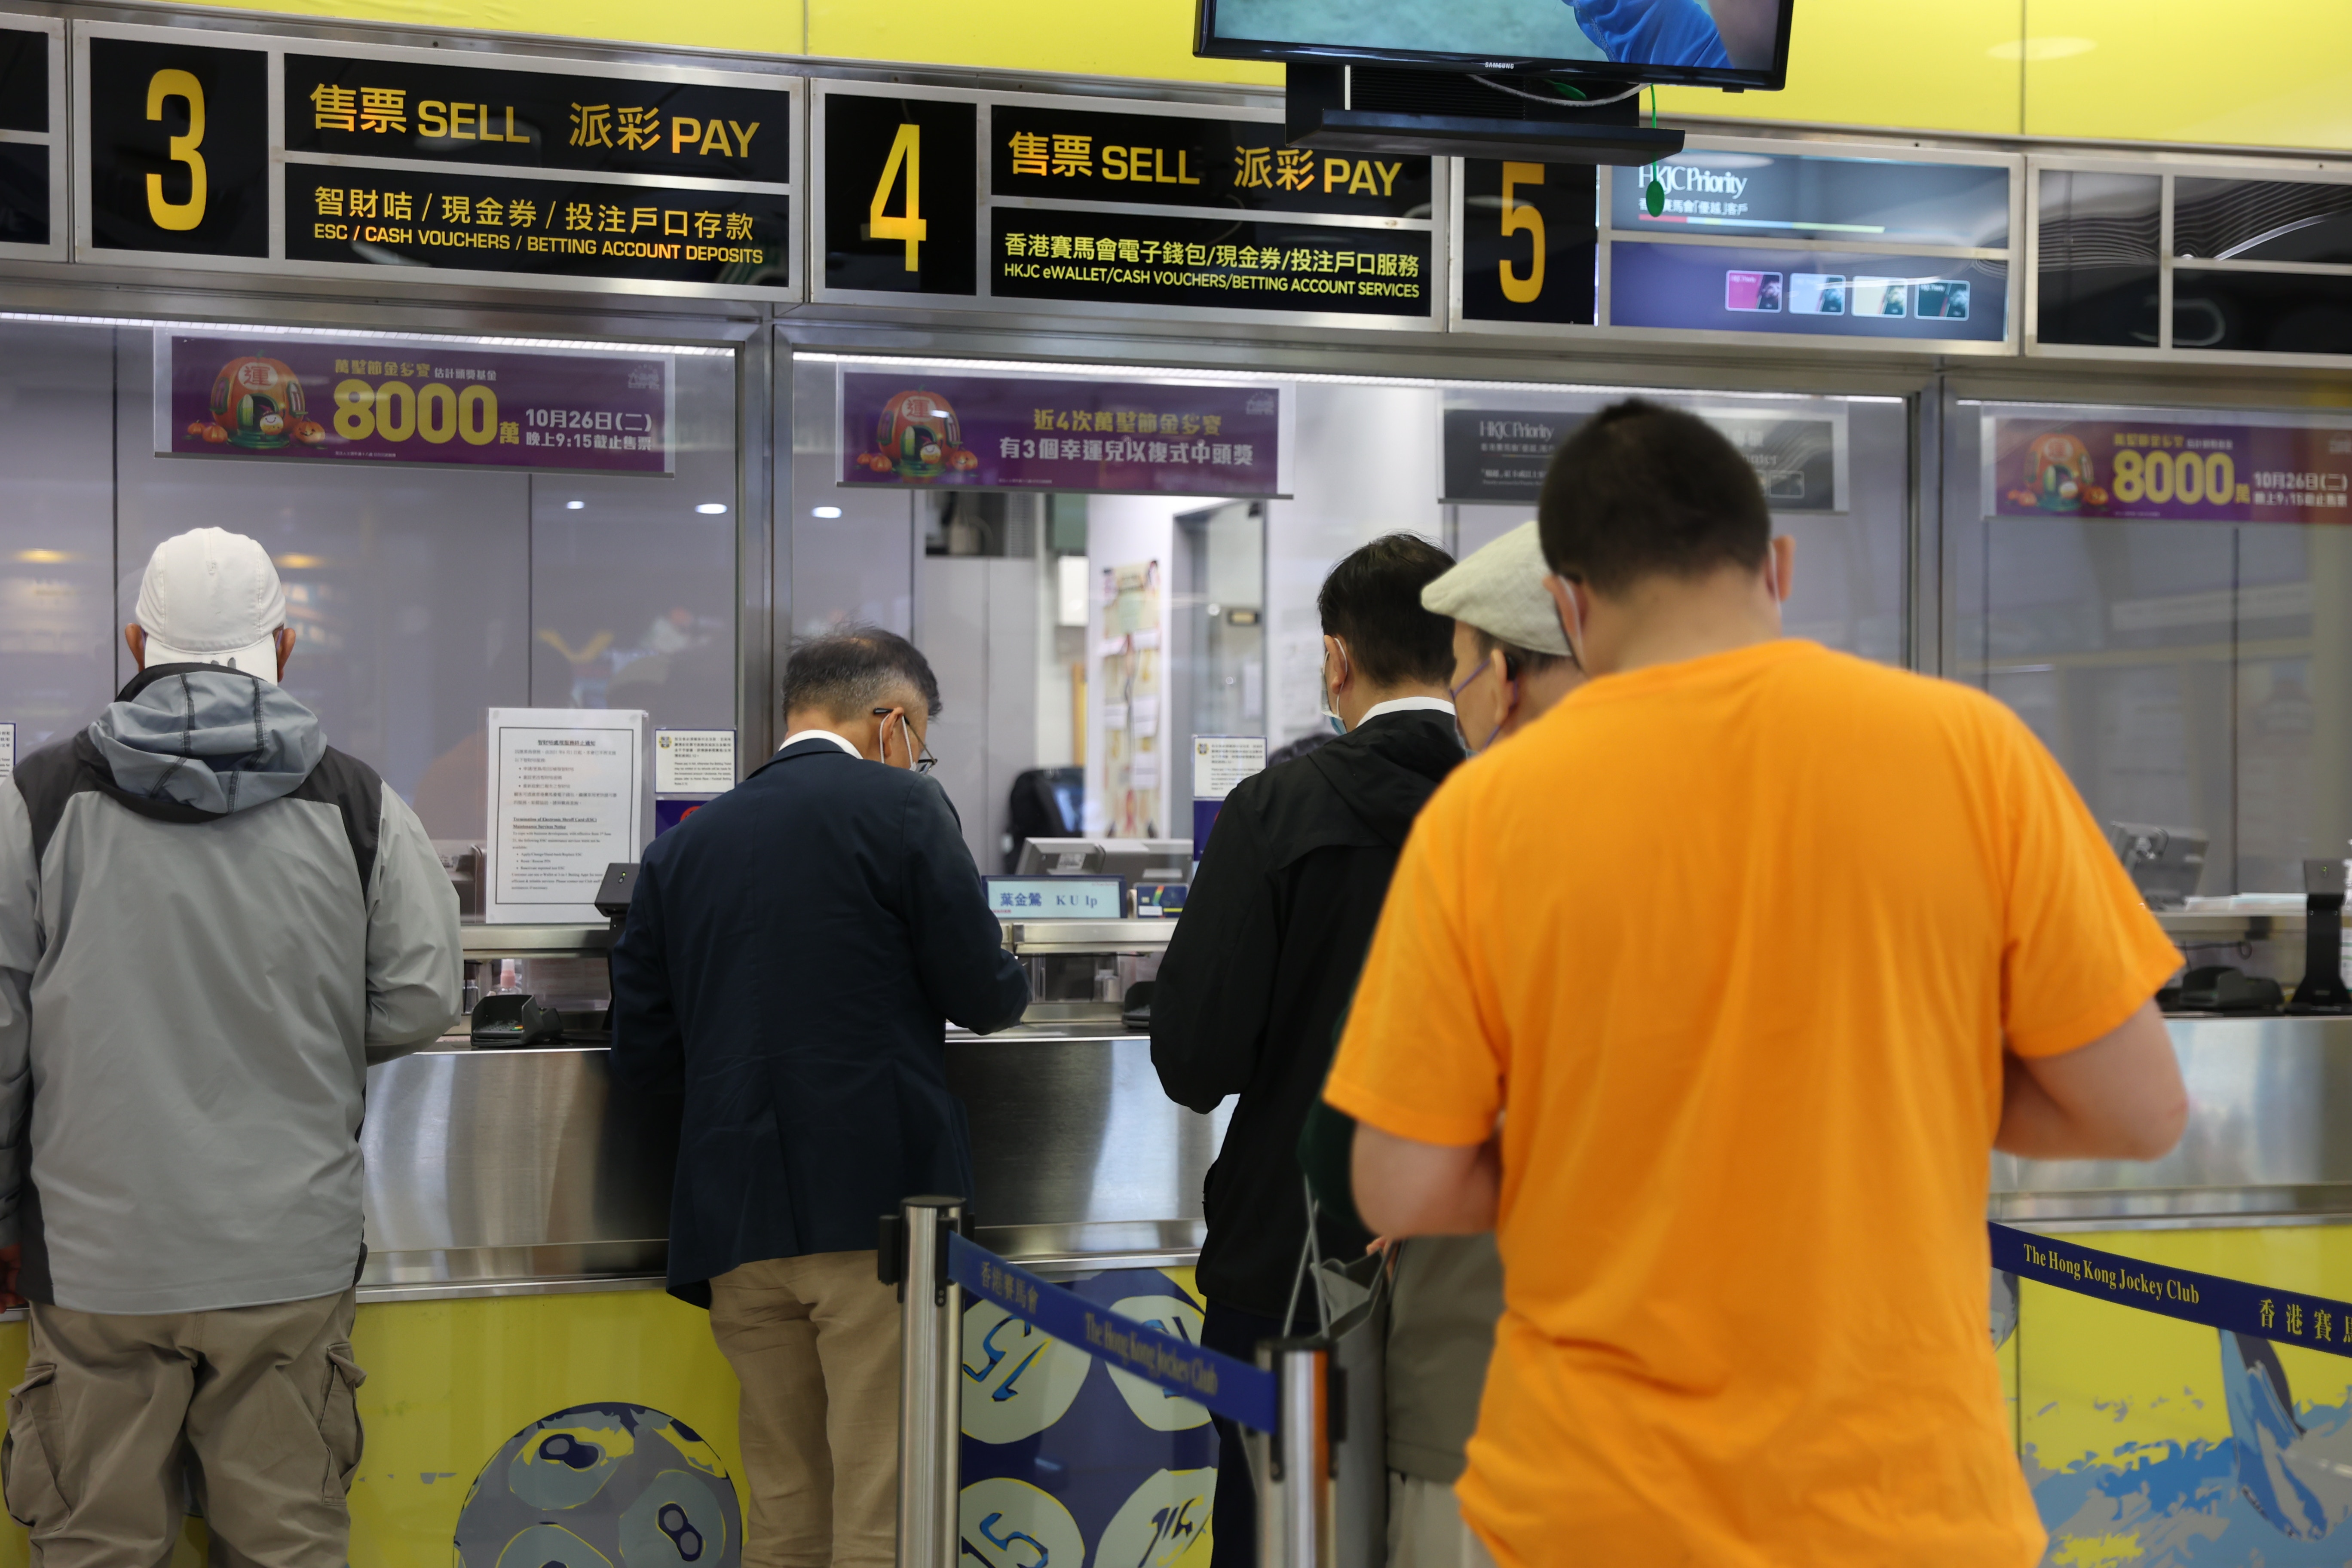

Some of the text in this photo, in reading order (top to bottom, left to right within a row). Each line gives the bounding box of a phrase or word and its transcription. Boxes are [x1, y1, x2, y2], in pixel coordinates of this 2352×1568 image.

[310, 83, 760, 157] 售票 SELL 派彩 PAY
[147, 70, 207, 231] 3
[1008, 131, 1402, 196] 售票 SELL 派彩 PAY
[315, 186, 413, 221] 智財咭
[442, 195, 536, 228] 現金券
[870, 123, 927, 272] 4
[1638, 165, 1748, 199] HKJC Priority
[315, 224, 348, 240] ESC
[365, 227, 412, 244] CASH
[418, 230, 510, 249] VOUCHERS
[527, 236, 597, 254] BETTING
[602, 241, 681, 259] ACCOUNT
[686, 245, 763, 263] DEPOSITS
[1500, 162, 1545, 303] 5
[1004, 263, 1040, 278] HKJC
[1290, 278, 1356, 295] ACCOUNT
[1358, 283, 1420, 298] SERVICES
[242, 365, 271, 388] 運
[981, 1261, 1039, 1315] 香港賽馬會
[2024, 1243, 2200, 1304] The Hong Kong Jockey Club
[1085, 1312, 1103, 1346] The
